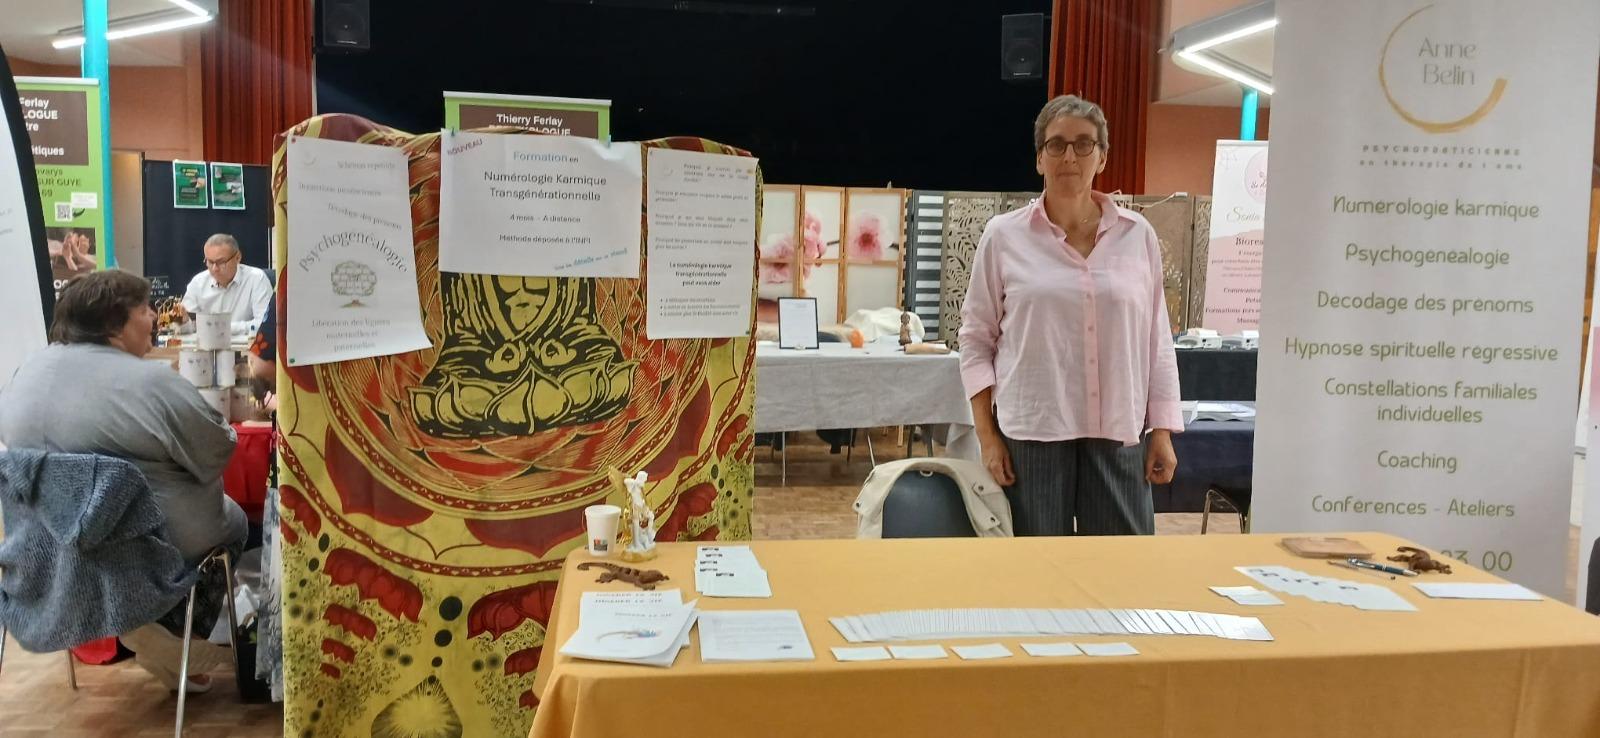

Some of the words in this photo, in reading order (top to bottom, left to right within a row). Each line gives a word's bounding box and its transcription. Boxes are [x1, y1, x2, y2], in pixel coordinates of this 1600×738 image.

[1418, 36, 1477, 58] Anne
[1423, 63, 1475, 86] Belin
[496, 113, 531, 126] Thierry
[533, 115, 563, 127] Ferlay
[447, 139, 483, 156] NOUVEAU
[513, 151, 568, 163] Formation
[57, 178, 81, 187] GUYE
[484, 171, 553, 185] Numérologie
[556, 173, 607, 187] Karmique
[551, 215, 582, 223] distance
[1455, 198, 1540, 222] karmique
[1414, 293, 1447, 311] des
[1285, 336, 1364, 360] Hypnose
[1370, 339, 1456, 362] spirituelle
[1324, 377, 1449, 398] Constellations
[1453, 380, 1538, 401] familiales
[1377, 404, 1483, 424] individuelles
[1377, 449, 1458, 474] Coaching
[1447, 497, 1516, 518] Ateliers
[1482, 550, 1513, 572] 00
